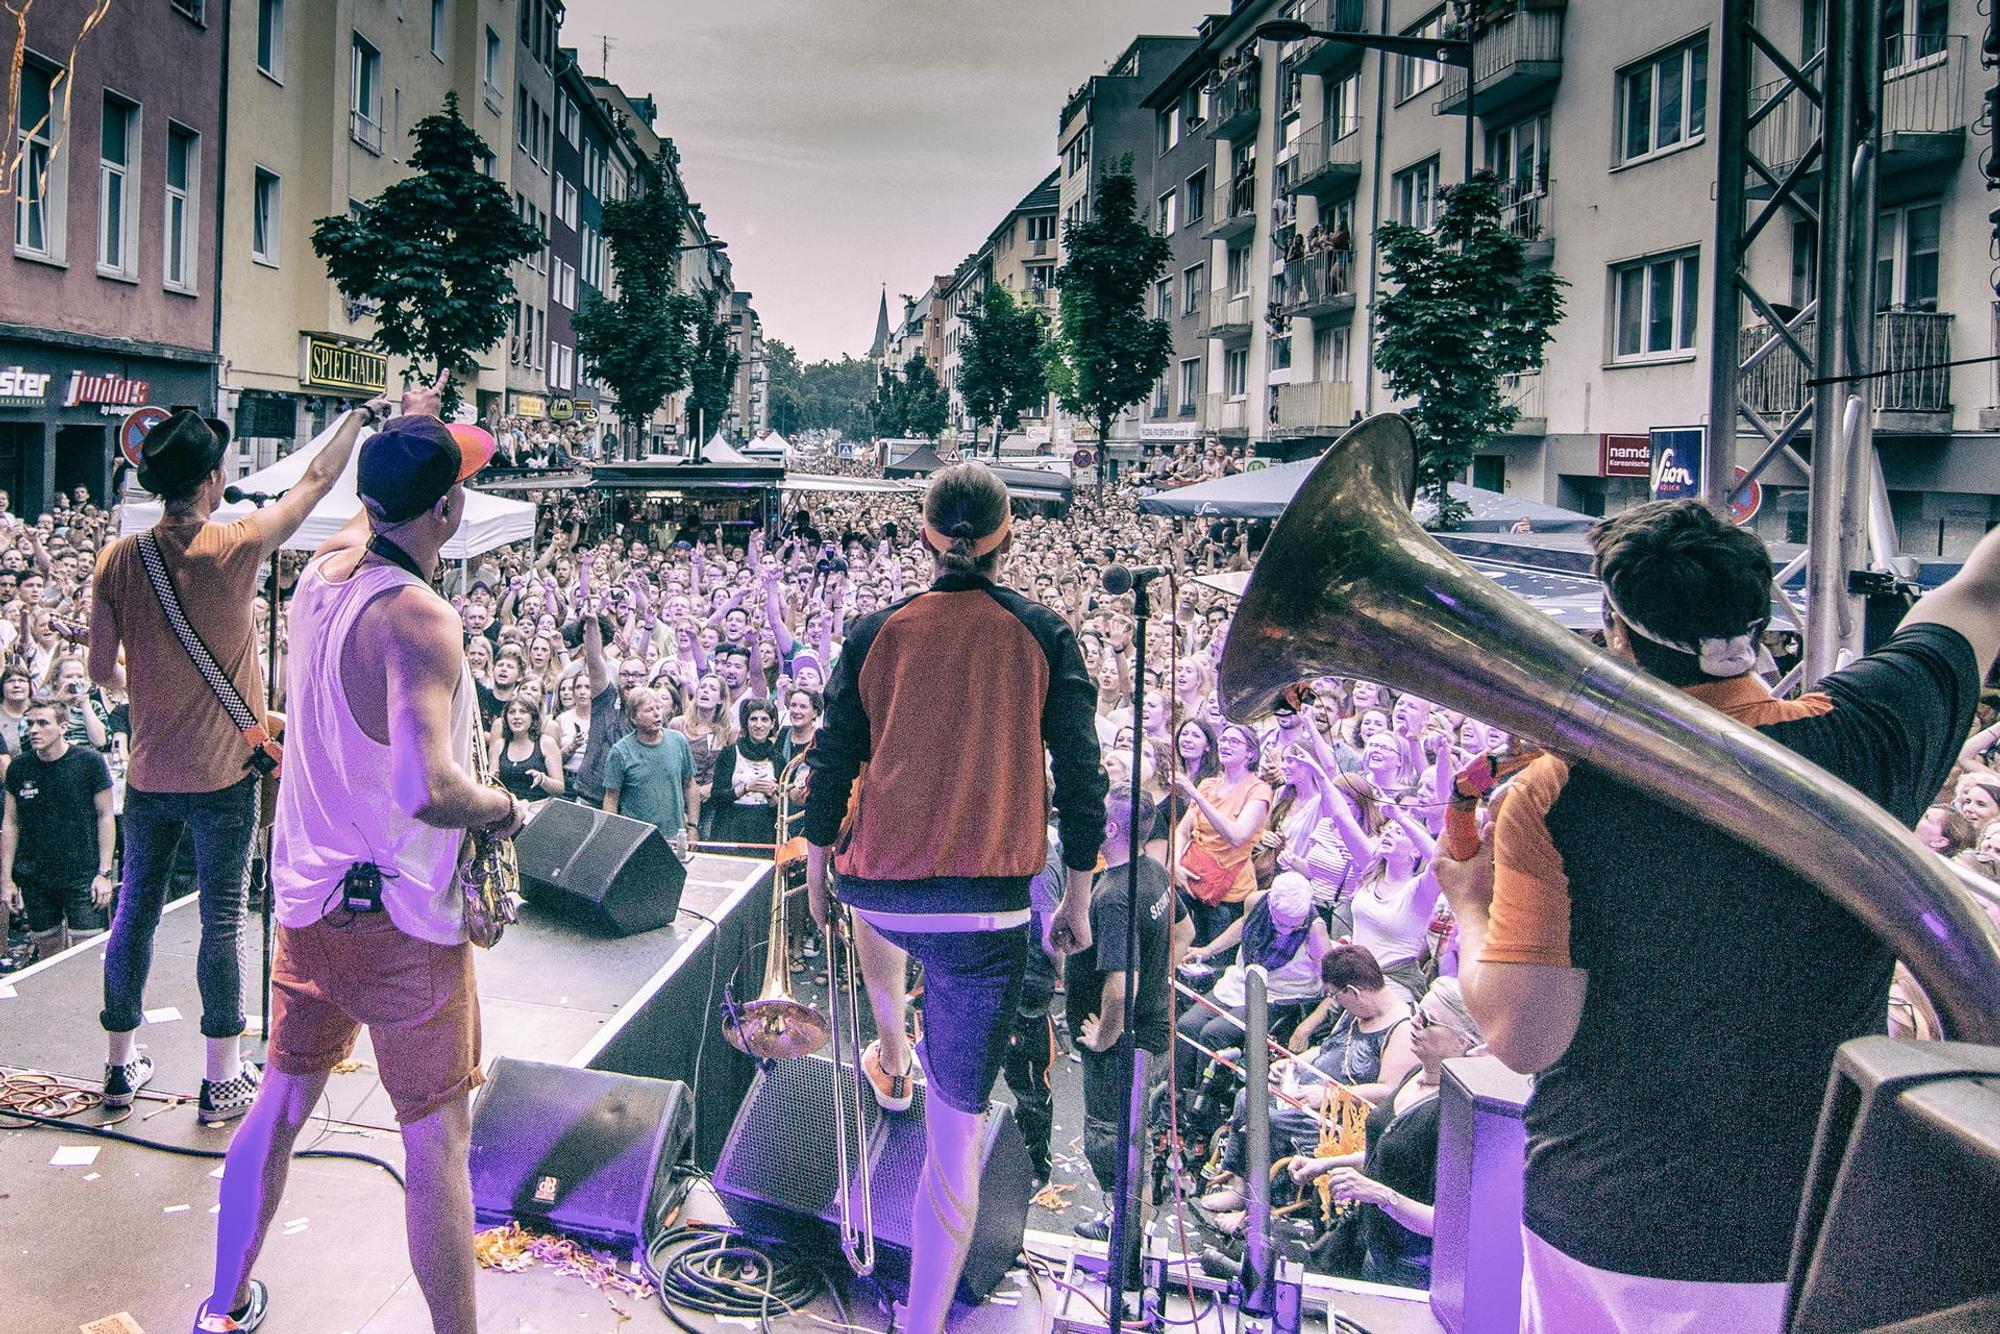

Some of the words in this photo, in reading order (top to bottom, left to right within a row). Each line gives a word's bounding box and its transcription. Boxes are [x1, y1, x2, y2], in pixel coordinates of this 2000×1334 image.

[312, 345, 386, 387] SPIELHALLE
[63, 370, 149, 407] juniors
[1651, 447, 1694, 493] Sion
